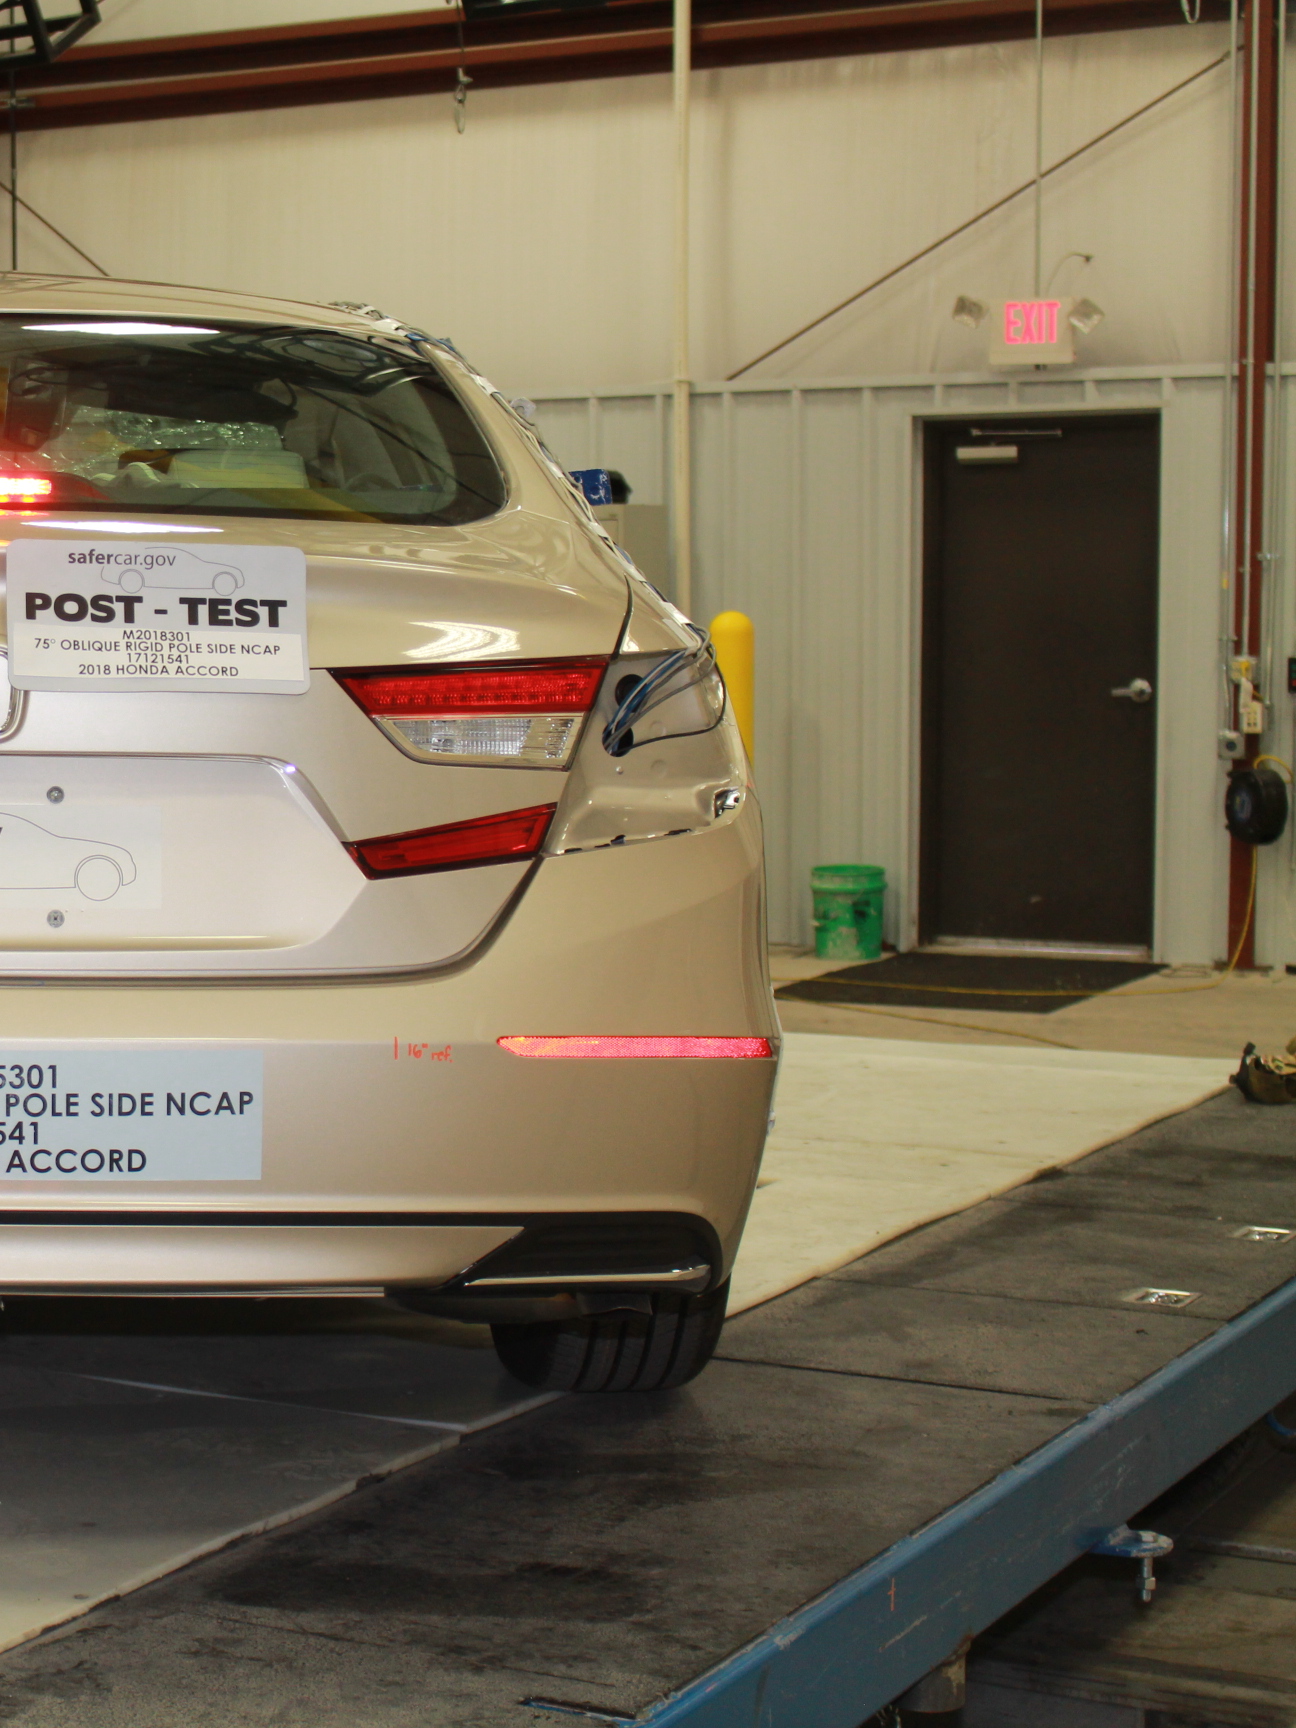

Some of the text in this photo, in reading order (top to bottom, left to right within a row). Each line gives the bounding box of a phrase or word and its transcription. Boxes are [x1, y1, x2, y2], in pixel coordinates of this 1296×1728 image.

[1005, 301, 1061, 344] EXIT
[68, 549, 176, 570] safercar.gov
[25, 592, 144, 624] POST
[179, 596, 288, 628] TEST
[122, 629, 191, 642] M2018301
[60, 639, 121, 653] OBLIQUE
[125, 641, 164, 652] RIGID
[168, 642, 203, 653] POLE
[206, 643, 236, 654] SIDE
[240, 644, 281, 655] NCAP
[126, 652, 190, 664] 17121541
[78, 664, 240, 677] 2018 HONDA ACCORD
[5, 1092, 79, 1118] POLE
[90, 1092, 154, 1118] SIDE
[166, 1091, 254, 1117] NCAP
[5, 1148, 147, 1174] ACCORD
